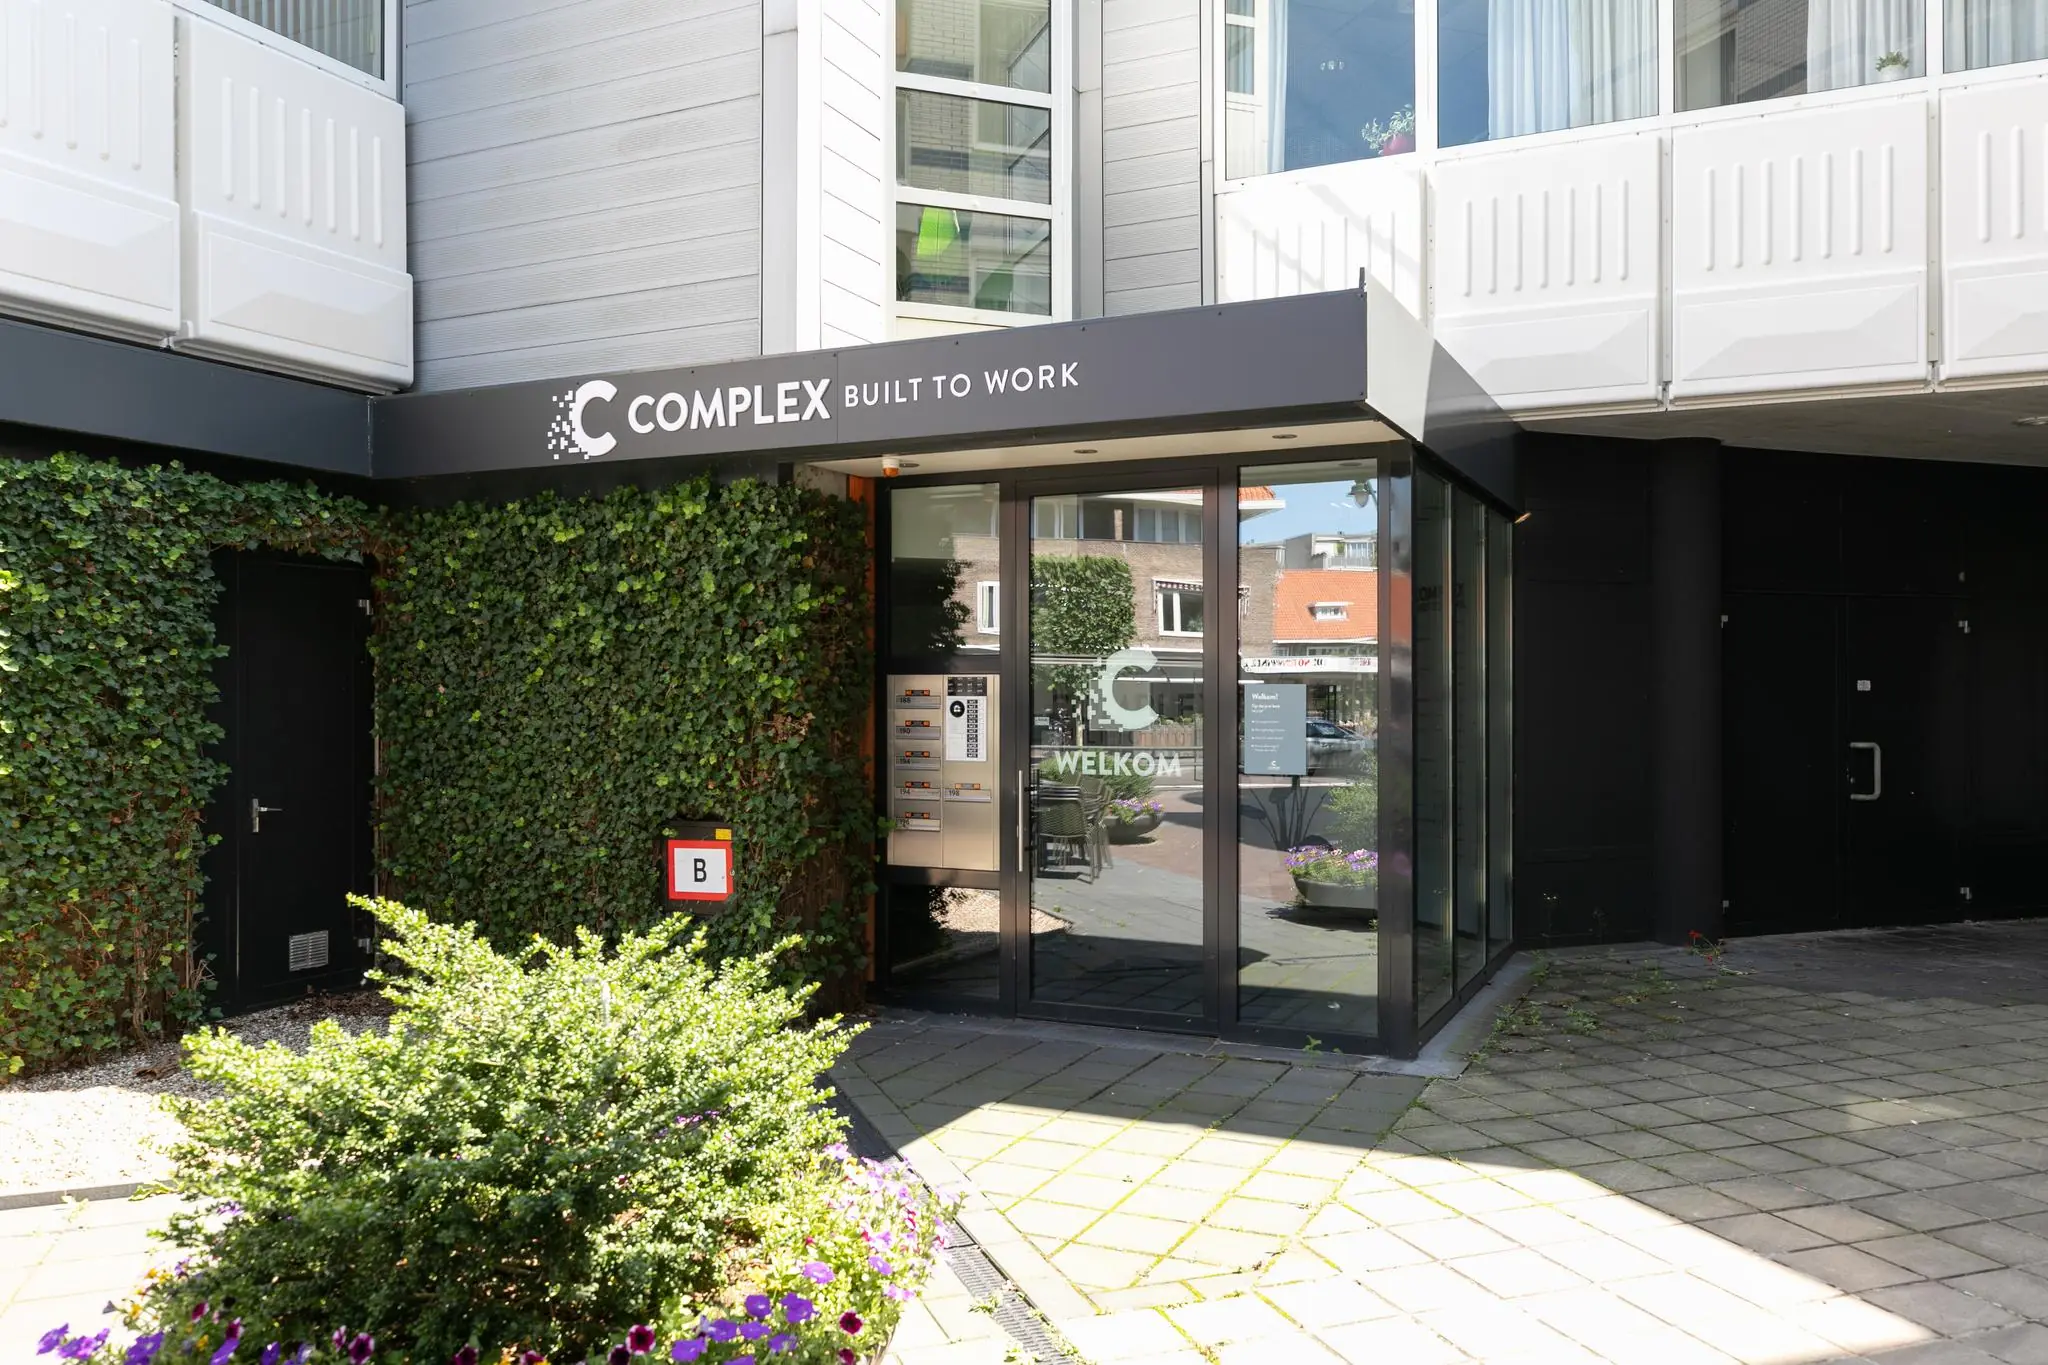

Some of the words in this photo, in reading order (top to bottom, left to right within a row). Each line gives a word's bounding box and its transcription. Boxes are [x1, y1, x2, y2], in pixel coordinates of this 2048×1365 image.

[628, 378, 832, 435] COMPLEX
[844, 377, 923, 408] BUILT
[932, 373, 972, 399] TO
[984, 361, 1080, 395] WORK
[1054, 750, 1182, 777] WELKOM
[693, 858, 707, 883] B
